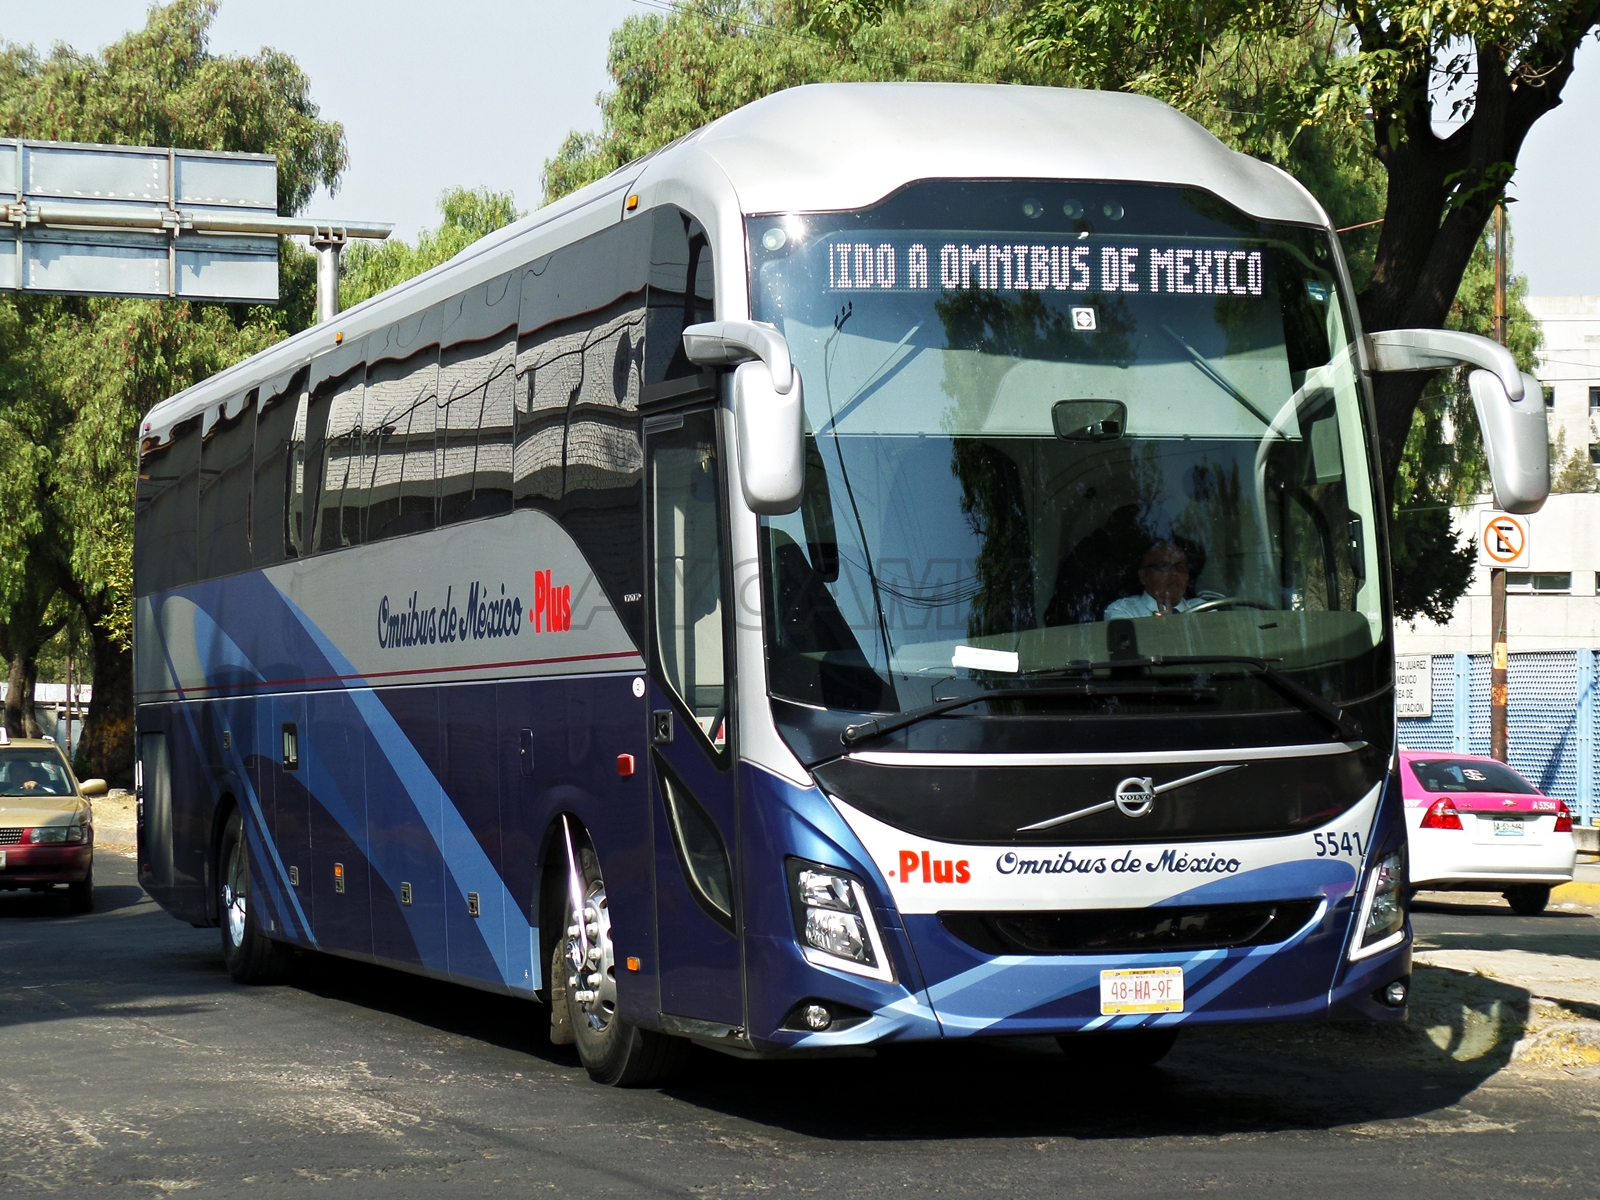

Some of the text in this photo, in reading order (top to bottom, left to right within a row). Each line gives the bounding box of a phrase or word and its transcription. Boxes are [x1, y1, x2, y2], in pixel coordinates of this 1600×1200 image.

[908, 243, 929, 289] A
[940, 243, 1091, 291] OMNIBUS
[1101, 246, 1140, 292] DE
[1150, 247, 1263, 296] MEXICO
[377, 590, 437, 649] Omnibus
[438, 585, 457, 644] de
[458, 580, 523, 641] México
[1312, 831, 1363, 857] 5541
[995, 849, 1107, 875] Omnibus
[1110, 850, 1142, 874] de
[1145, 850, 1242, 874] México
[1111, 979, 1173, 1000] 48-HA-9F
